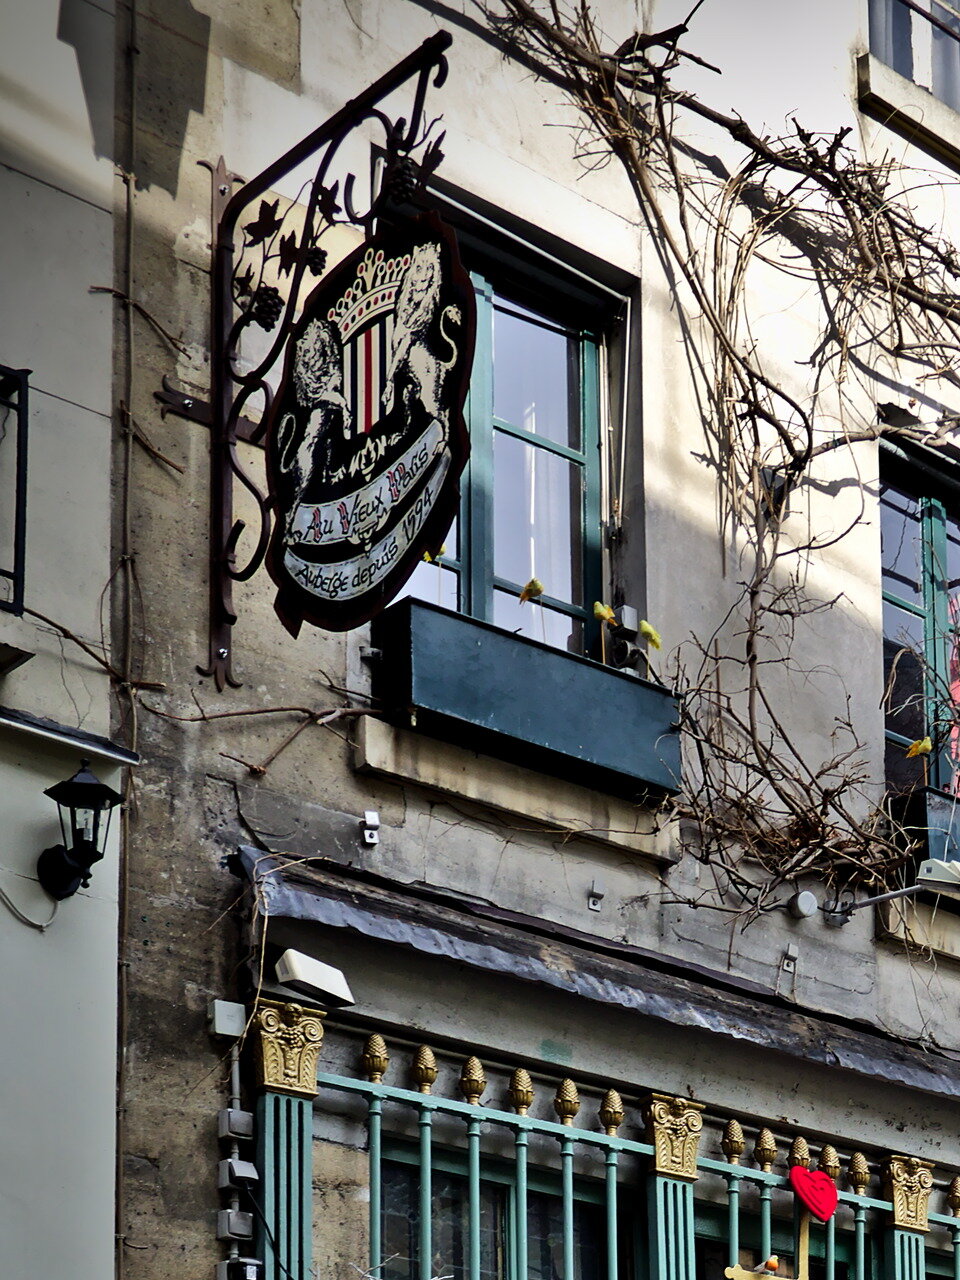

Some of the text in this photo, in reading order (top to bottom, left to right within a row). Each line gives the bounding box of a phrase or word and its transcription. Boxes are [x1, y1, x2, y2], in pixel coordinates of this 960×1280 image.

[295, 486, 433, 598] Auberge depuis 1594
[302, 442, 429, 543] Au Vieux Paris
